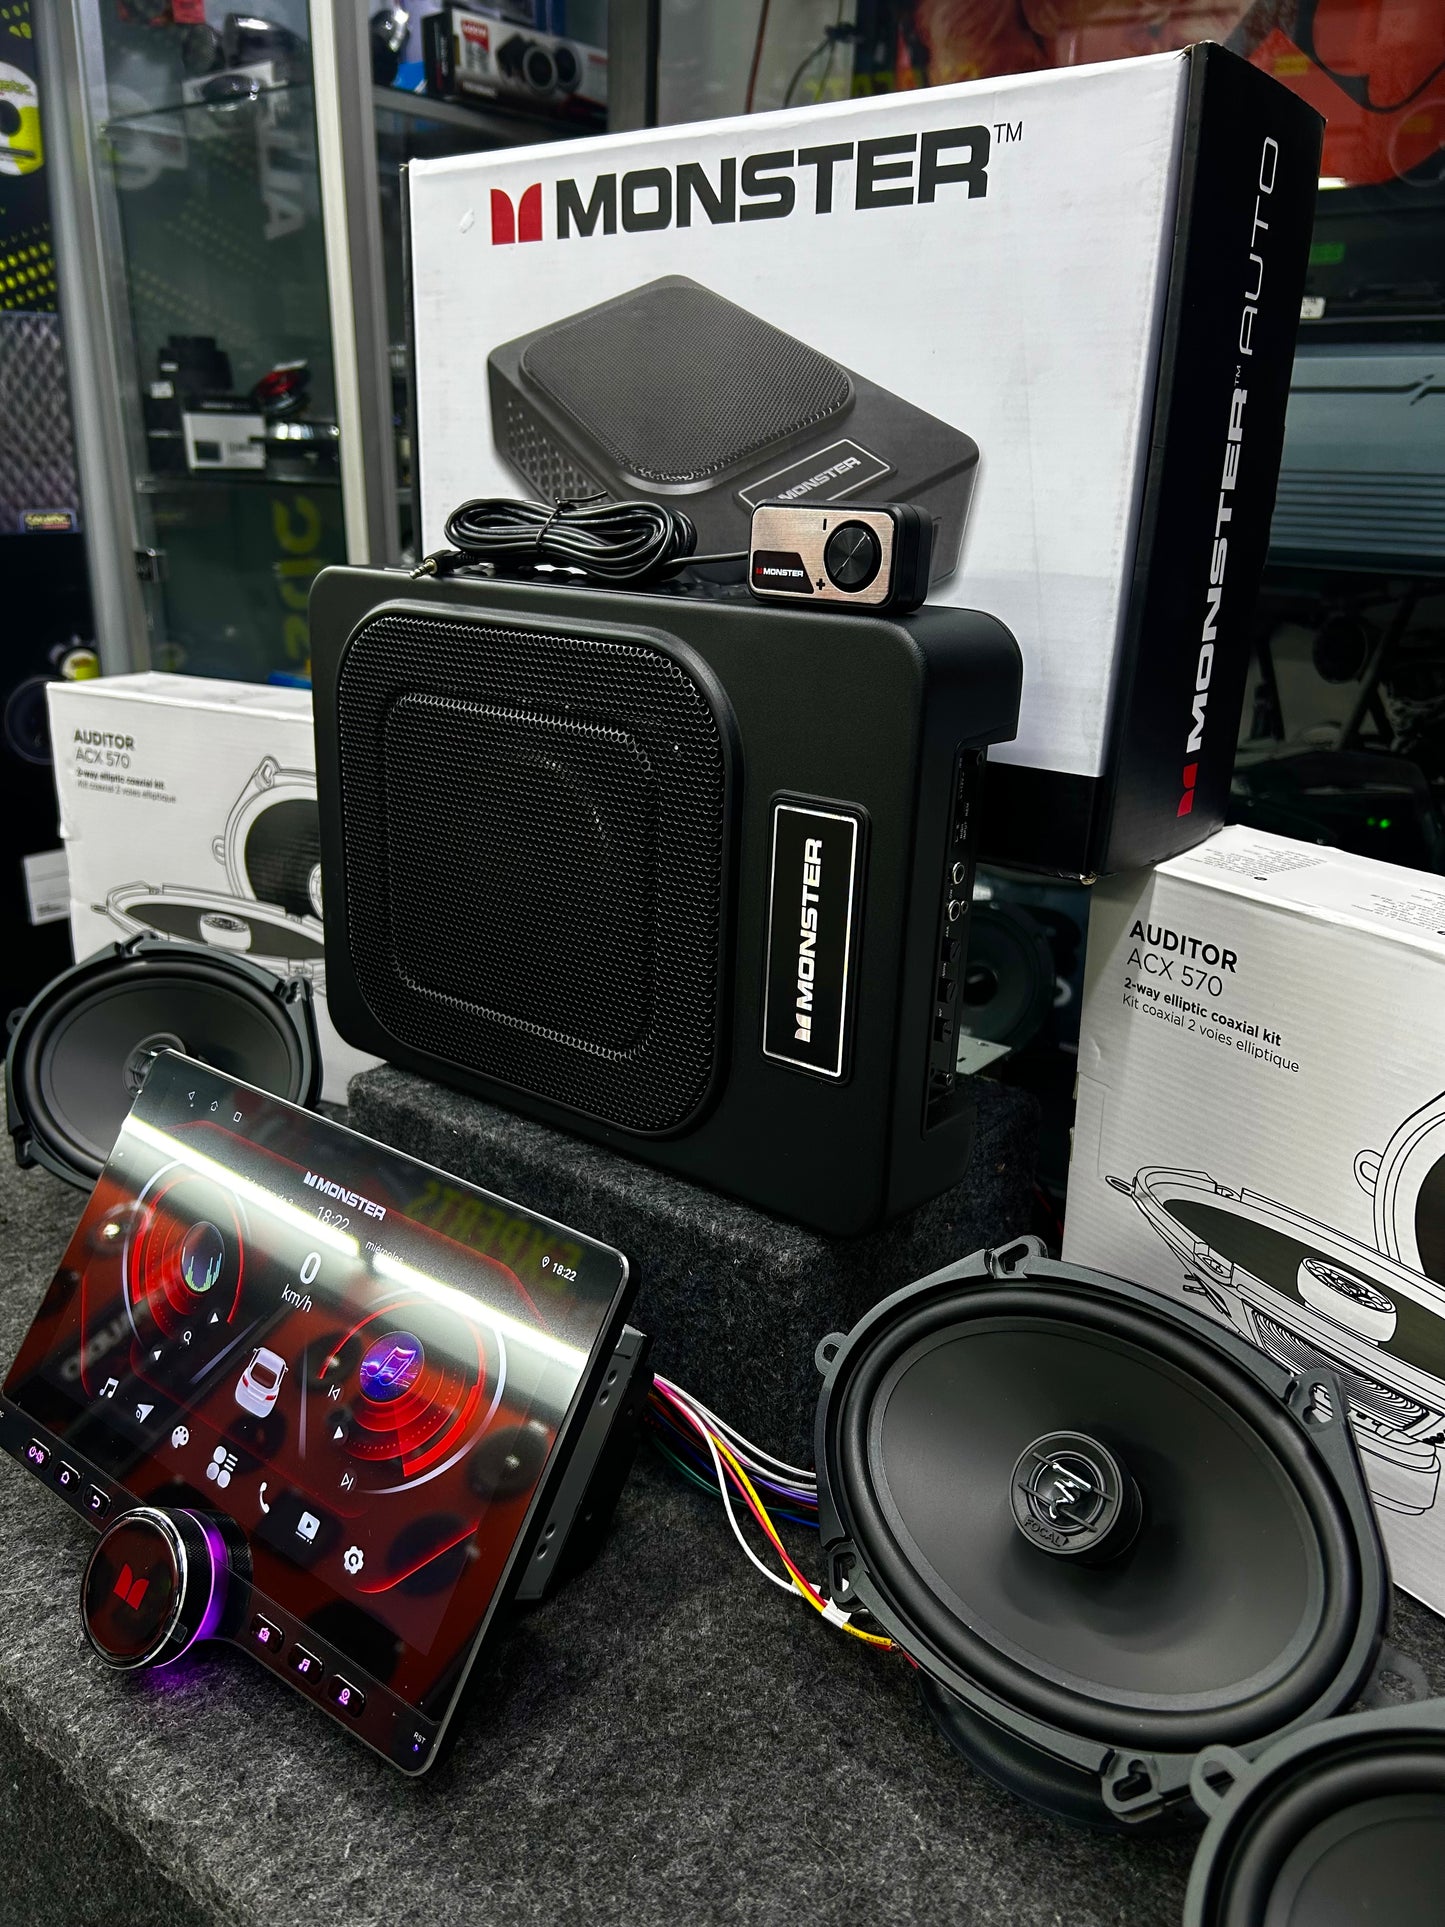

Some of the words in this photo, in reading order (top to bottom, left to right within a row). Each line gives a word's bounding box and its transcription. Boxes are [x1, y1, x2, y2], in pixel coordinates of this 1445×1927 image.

[556, 125, 991, 240] MONSTER
[1186, 388, 1248, 753] MONSTER
[1239, 136, 1279, 355] AUTO
[777, 456, 862, 500] MONSTER
[763, 567, 804, 578] MONSTER
[74, 728, 135, 751] AUDITOR
[75, 747, 103, 765] ACX
[105, 750, 131, 769] 570
[796, 838, 823, 1012] MONSTER
[1129, 920, 1239, 973] AUDITOR
[1127, 948, 1174, 981] ACX
[1181, 965, 1223, 997] 570
[1124, 977, 1160, 1001] 2-way
[1163, 993, 1208, 1018] elliptic
[1211, 1011, 1259, 1038] coaxial
[1262, 1028, 1282, 1046] kit
[1122, 993, 1139, 1010] Kit
[1142, 1002, 1185, 1027] coaxial
[1187, 1019, 1196, 1032] 2
[1200, 1024, 1232, 1046] voies
[1236, 1039, 1300, 1073] elliptique
[314, 1176, 387, 1221] MONSTER
[315, 1206, 350, 1234] 18:22
[300, 1252, 321, 1284] 0
[552, 1262, 577, 1282] 18:22
[281, 1283, 312, 1313] km/h
[1023, 1518, 1065, 1547] FOCAL
[413, 1731, 426, 1744] RST
